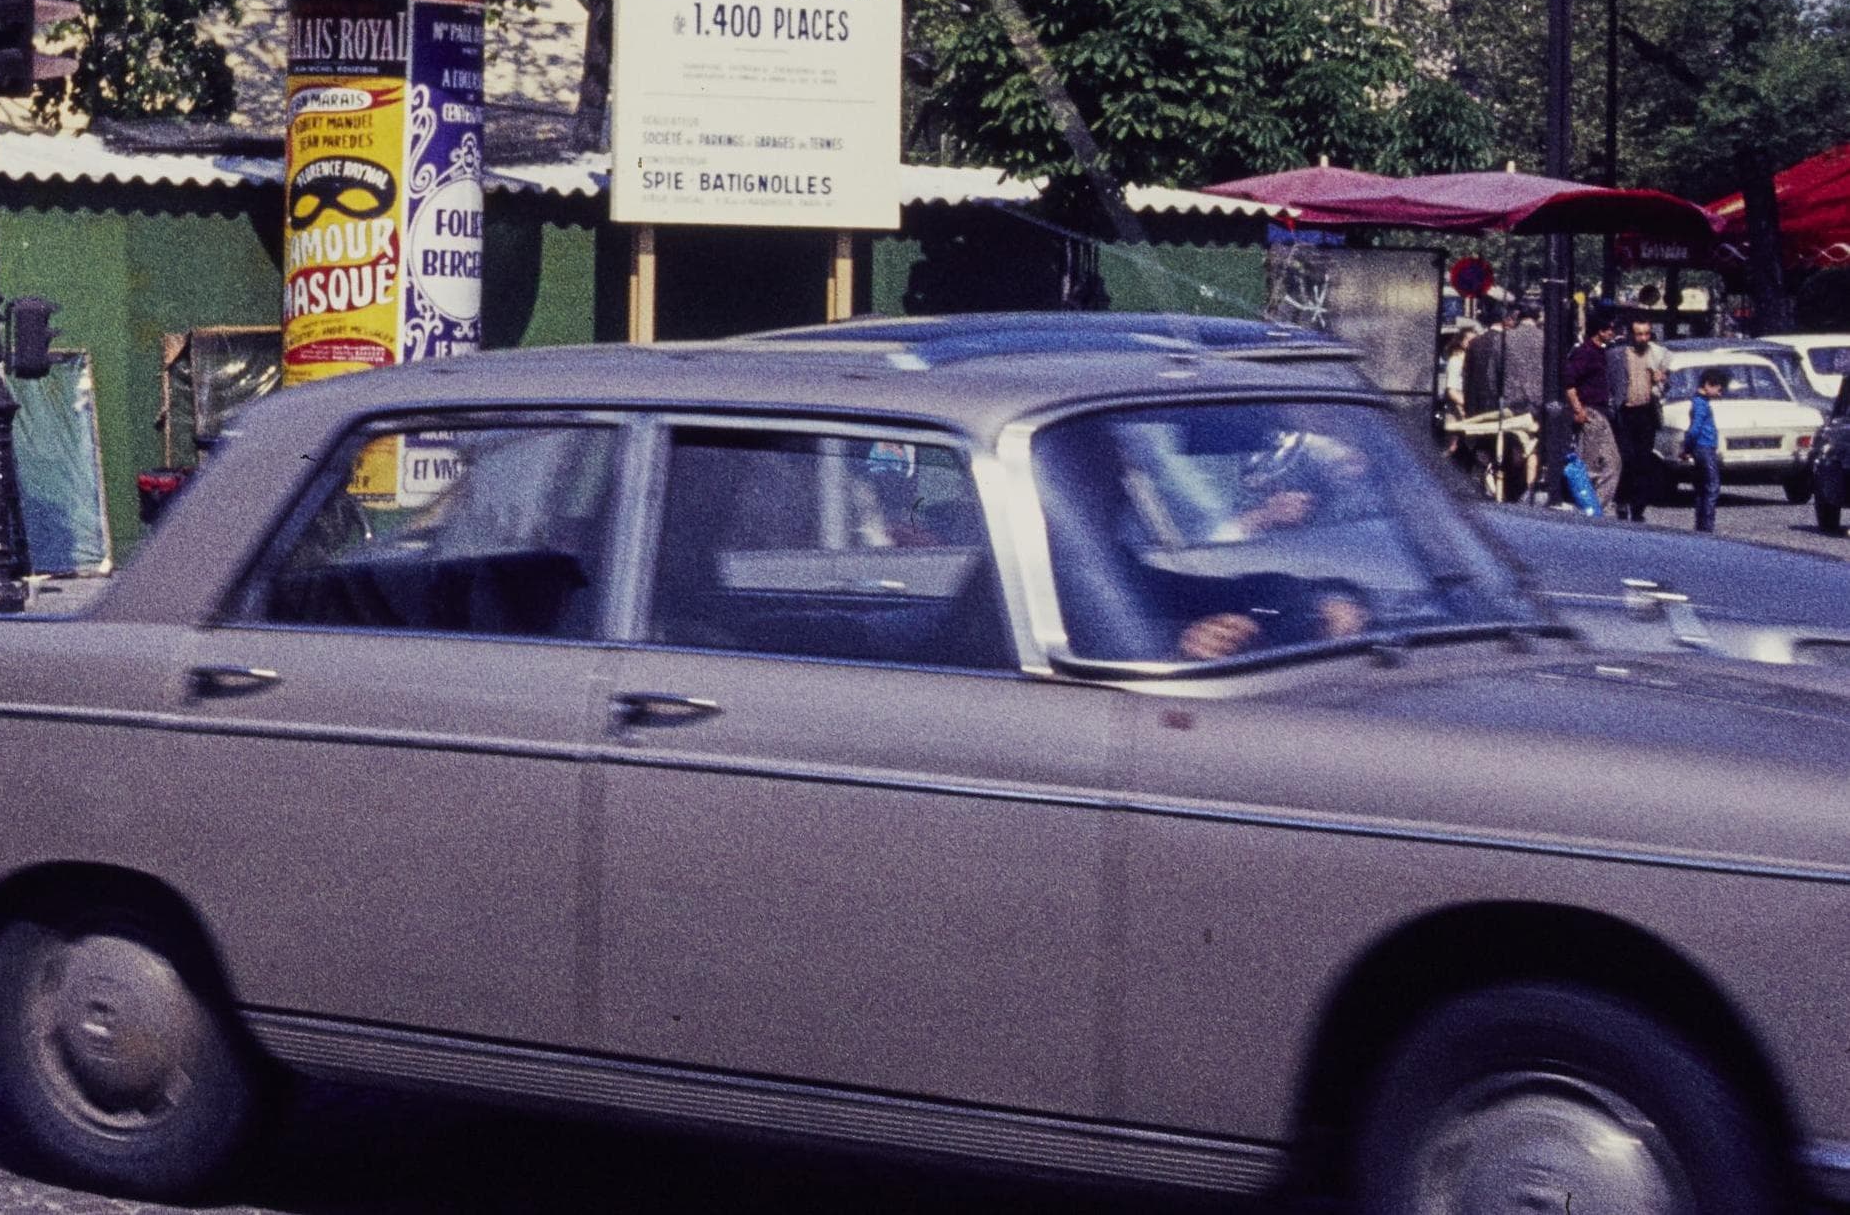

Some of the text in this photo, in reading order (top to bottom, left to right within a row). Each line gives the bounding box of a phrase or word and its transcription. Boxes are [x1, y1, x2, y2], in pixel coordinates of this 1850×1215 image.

[694, 2, 761, 39] 1.400
[774, 7, 850, 42] PLACES
[310, 93, 365, 107] MARAIS
[642, 171, 832, 195] SPIE BATIGNOLLES
[290, 218, 395, 269] AMOUR
